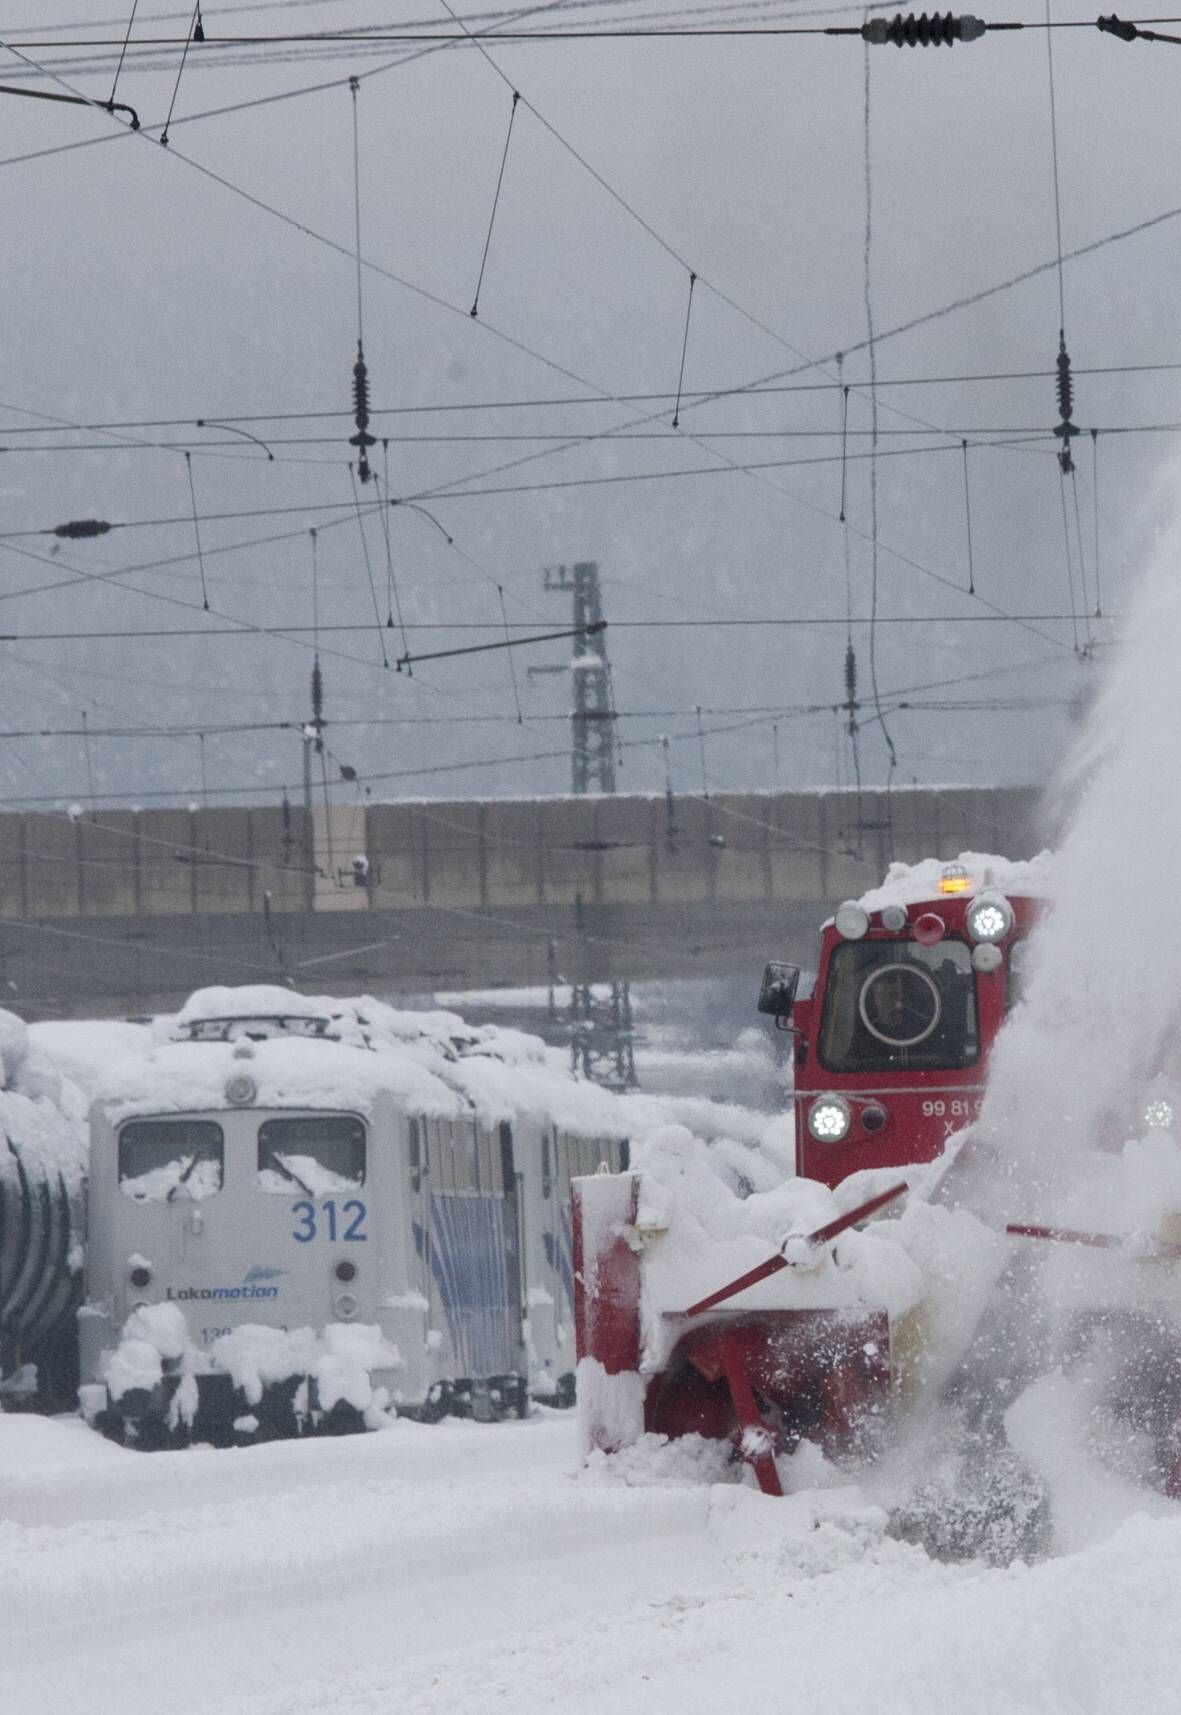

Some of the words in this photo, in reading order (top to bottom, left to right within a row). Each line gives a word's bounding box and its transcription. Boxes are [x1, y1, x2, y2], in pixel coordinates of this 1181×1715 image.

[922, 1100, 946, 1116] 99
[951, 1099, 969, 1115] 81
[292, 1199, 367, 1242] 312
[166, 1283, 279, 1301] Lokomotion
